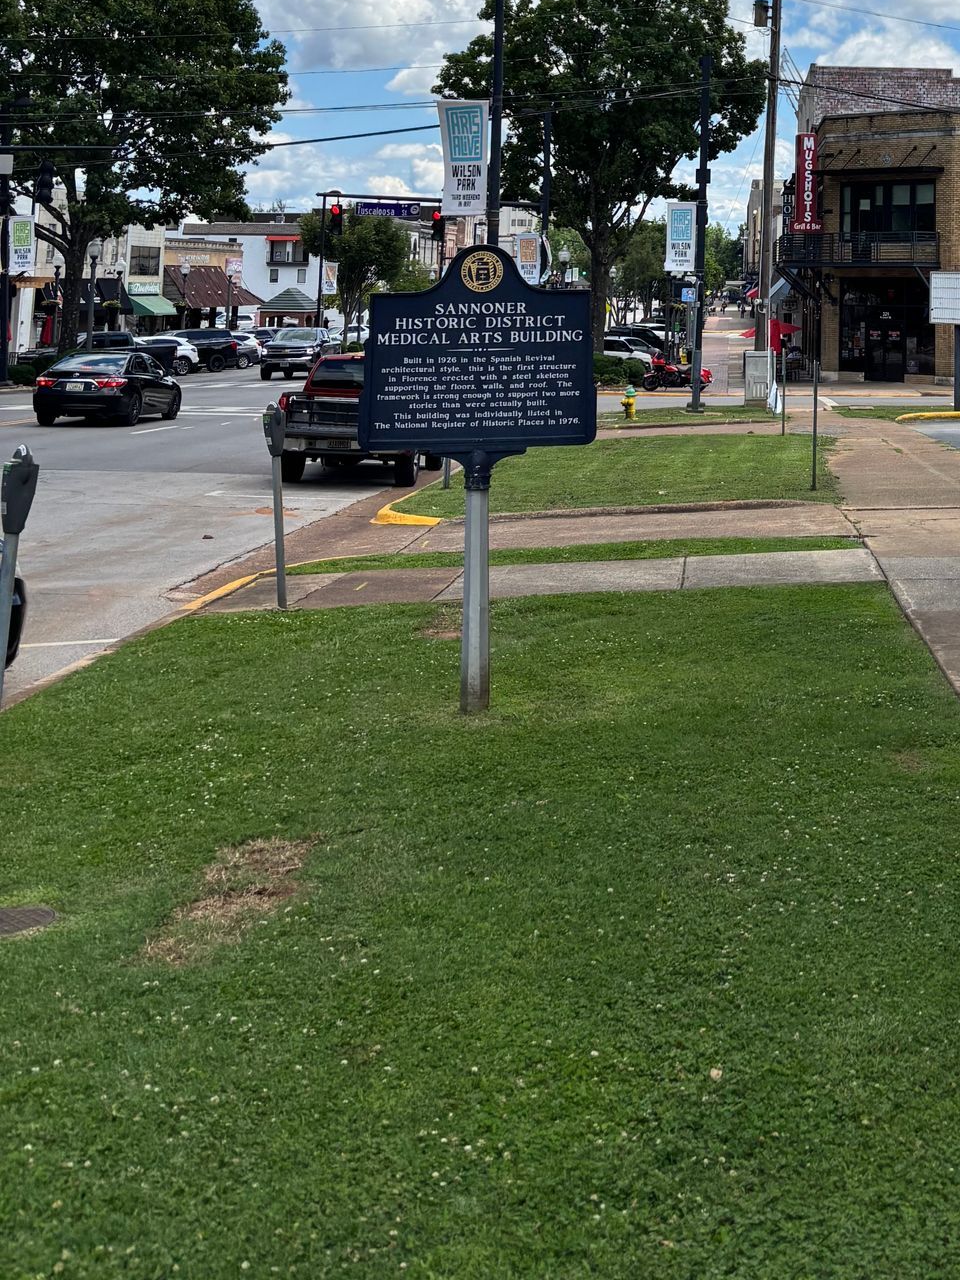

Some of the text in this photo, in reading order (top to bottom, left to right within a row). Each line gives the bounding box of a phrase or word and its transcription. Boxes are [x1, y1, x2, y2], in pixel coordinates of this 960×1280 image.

[456, 178, 476, 191] PARK
[803, 136, 815, 222] MUGSHOTS
[357, 206, 395, 216] Tuscaloosa
[793, 222, 806, 230] Grill
[435, 302, 527, 315] SANNONER
[395, 315, 566, 330] HISTORIC DISTRICT
[377, 329, 583, 345] MEDICAL ARTS BUILDING
[403, 357, 422, 365] Built
[490, 355, 522, 363] Spanish
[525, 354, 556, 362] Revival
[381, 366, 435, 374] architectural
[468, 364, 484, 372] this
[442, 374, 474, 382] erected
[480, 373, 498, 381] with
[384, 384, 429, 393] supporting
[509, 381, 525, 389] and
[556, 380, 573, 388] The
[377, 393, 420, 401] framework
[433, 392, 459, 401] strong
[462, 392, 492, 400] enough
[507, 390, 538, 399] support
[489, 400, 522, 408] actually
[393, 412, 412, 420] This
[416, 411, 450, 421] building
[474, 410, 523, 419] individually
[394, 421, 428, 429] National
[431, 421, 466, 430] Register
[482, 419, 515, 427] Historic
[518, 418, 545, 426] Places
